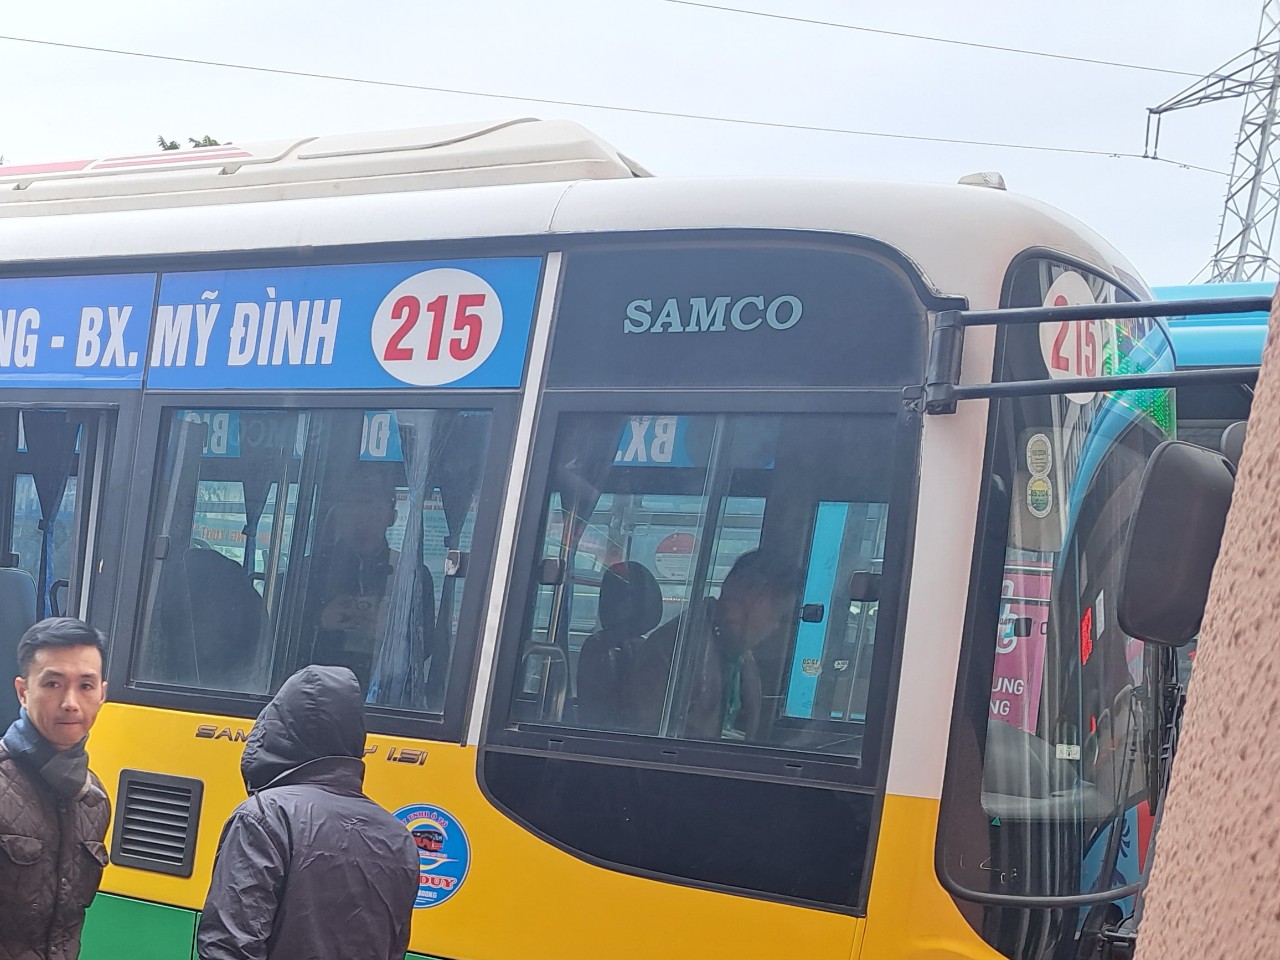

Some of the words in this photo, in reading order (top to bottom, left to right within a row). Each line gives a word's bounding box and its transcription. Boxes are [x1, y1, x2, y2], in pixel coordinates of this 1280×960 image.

[152, 290, 221, 367] MỸ
[229, 286, 341, 366] ĐÌNH
[383, 294, 487, 361] 215
[623, 295, 803, 334] SAMCO
